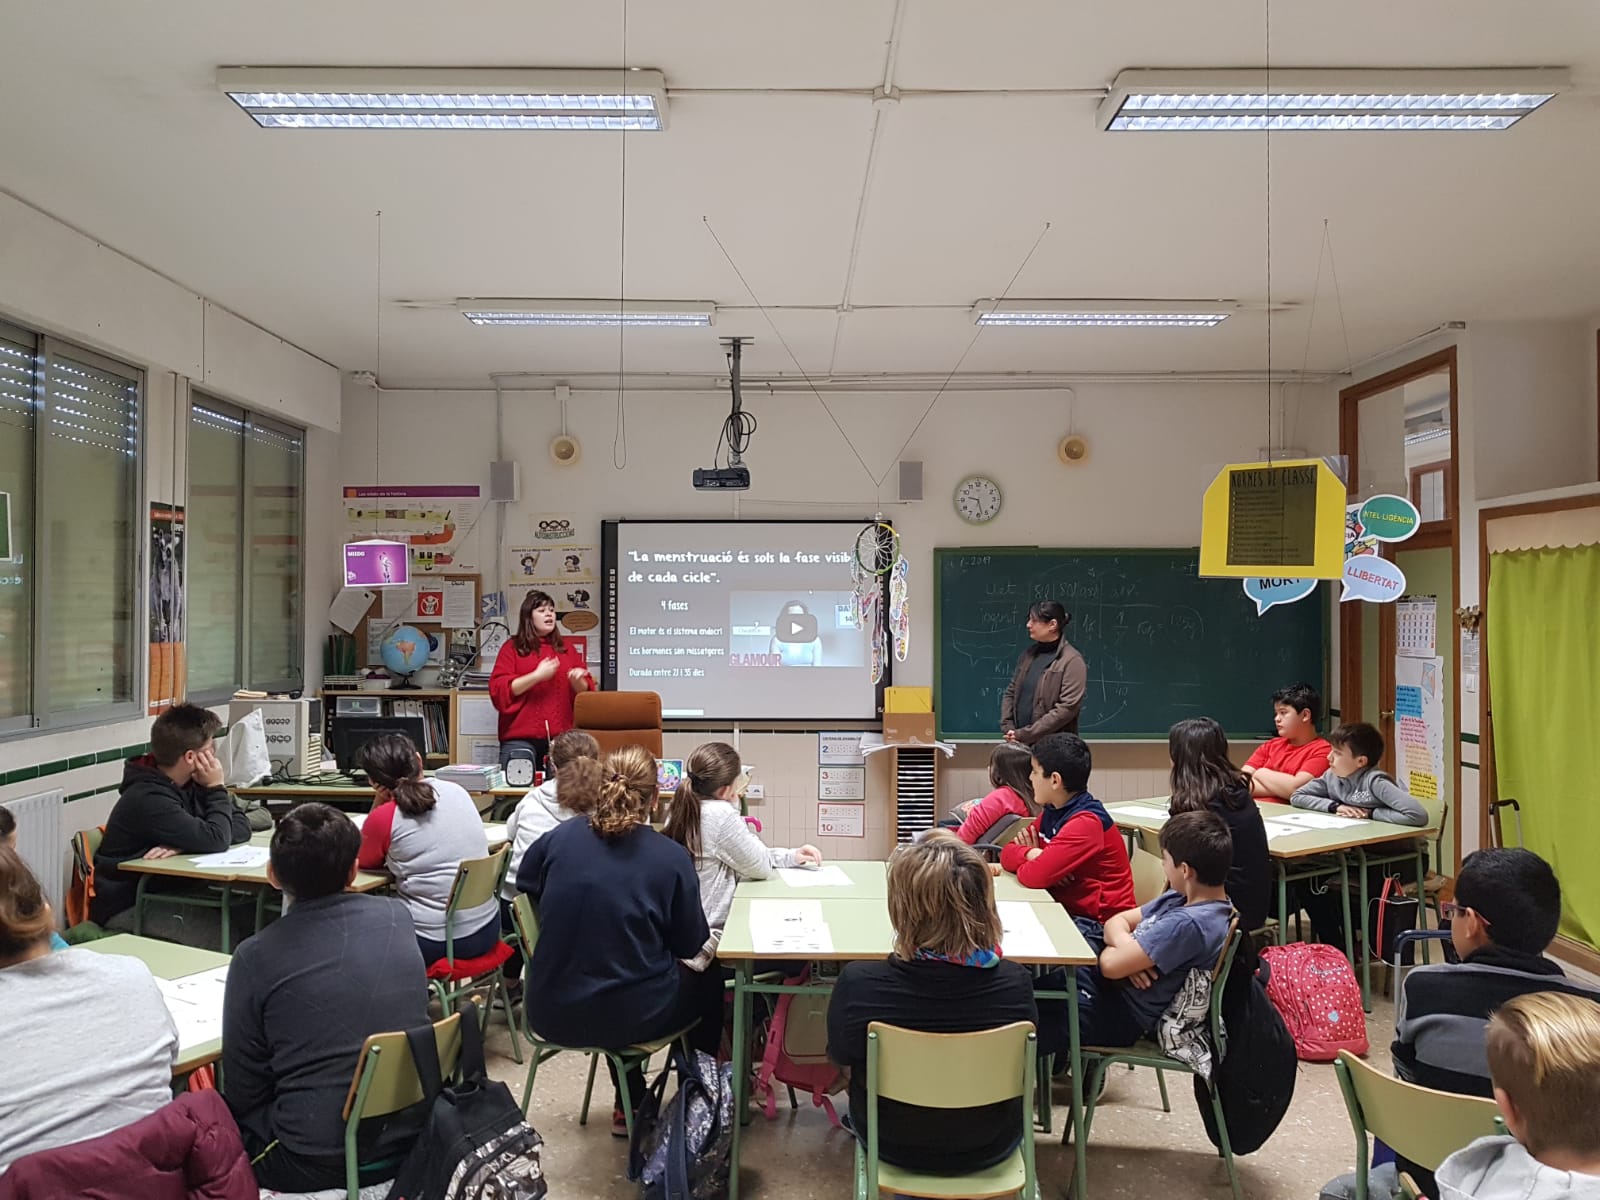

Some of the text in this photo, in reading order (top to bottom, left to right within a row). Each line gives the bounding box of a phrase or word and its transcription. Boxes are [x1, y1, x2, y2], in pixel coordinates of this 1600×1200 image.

[1231, 471, 1263, 488] NORMES
[1281, 466, 1315, 486] CLASSE
[654, 550, 733, 563] menstruació
[737, 550, 750, 563] és
[754, 551, 775, 563] sols
[780, 551, 791, 563] la
[794, 551, 820, 563] fase
[825, 551, 852, 563] visib
[627, 570, 643, 582] de
[648, 571, 678, 583] cada
[1347, 566, 1399, 591] LLIBERTAT
[660, 600, 689, 611] 4 fases
[629, 626, 637, 635] El
[637, 627, 657, 635] motor
[666, 627, 672, 635] el
[673, 627, 698, 635] sistema
[629, 647, 641, 655] Les
[641, 646, 672, 655] hormones
[686, 647, 725, 657] missatgeres
[729, 653, 782, 667] GLAMOUR
[629, 667, 652, 677] Durada
[653, 668, 672, 677] entre
[692, 668, 705, 677] dies
[822, 745, 829, 753] 2
[821, 771, 829, 780] 3
[825, 787, 832, 795] 5
[822, 823, 833, 832] 10
